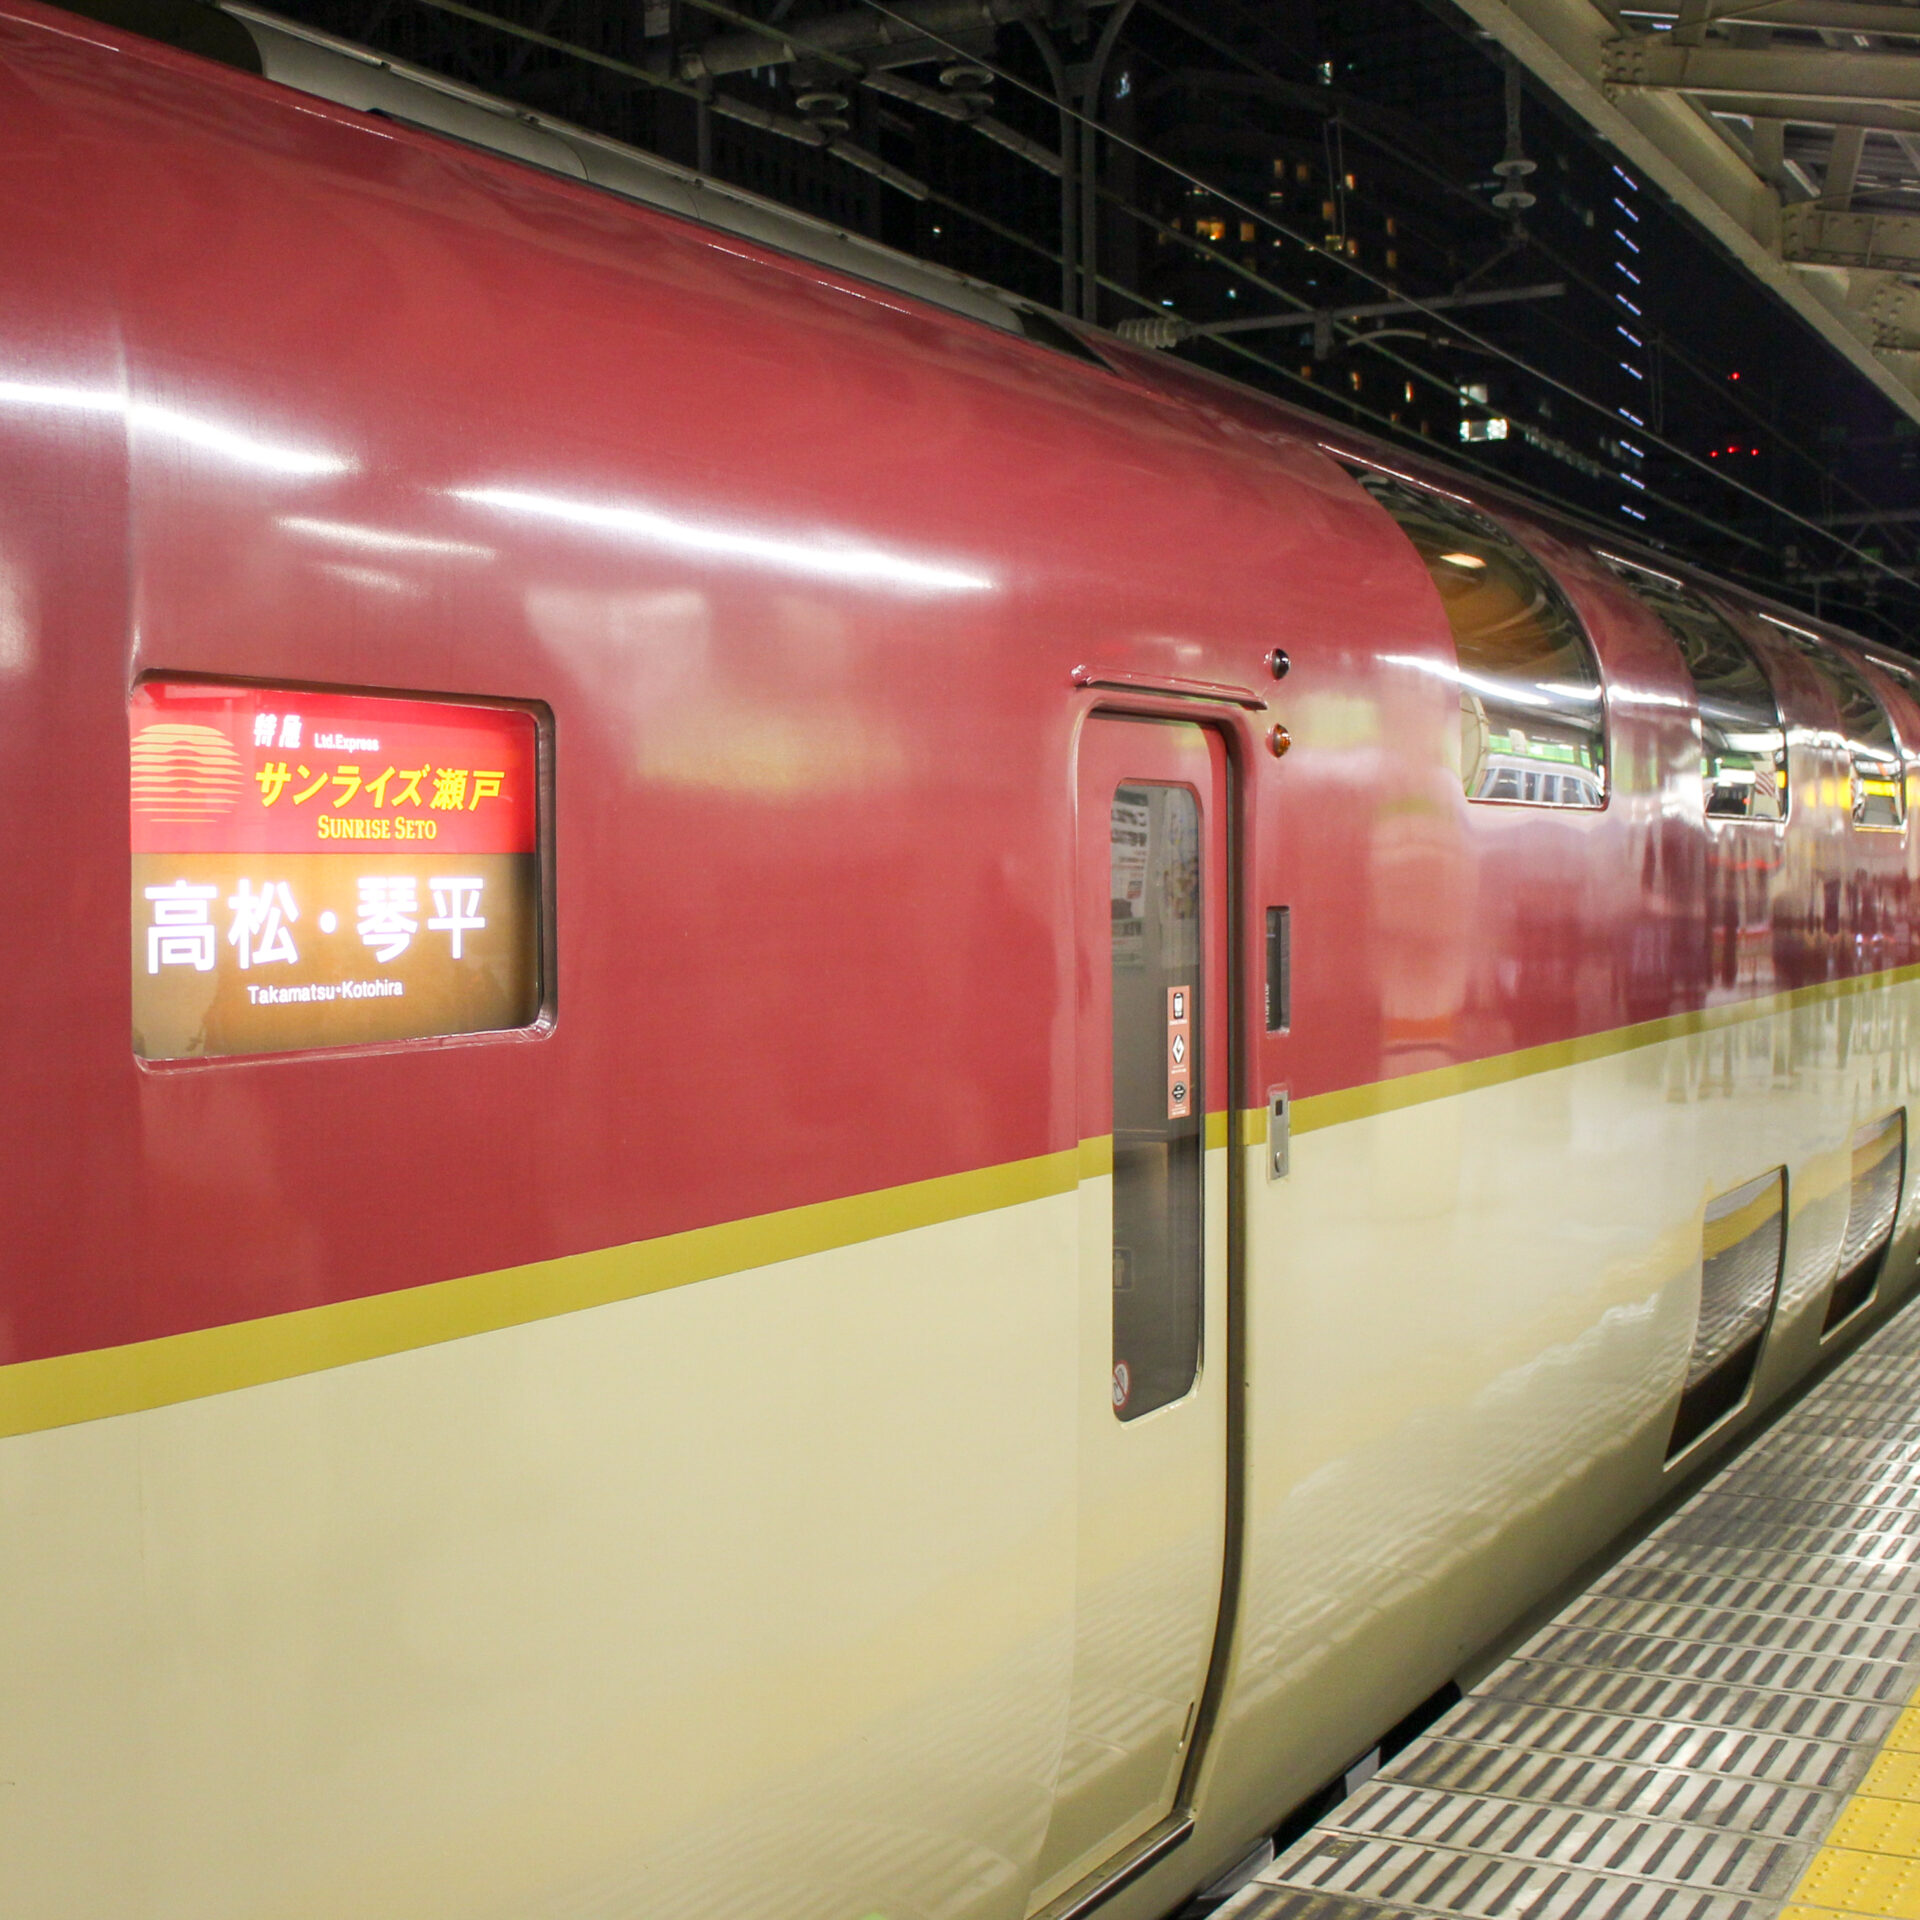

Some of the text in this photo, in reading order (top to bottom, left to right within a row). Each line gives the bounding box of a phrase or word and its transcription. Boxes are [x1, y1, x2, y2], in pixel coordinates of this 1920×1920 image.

[253, 713, 302, 748] 特急
[314, 733, 379, 752] Ltd.Express
[255, 762, 505, 811] サンライズ瀬戸
[318, 815, 437, 839] SUNRISE SETO
[145, 876, 486, 975] 高松・琴平
